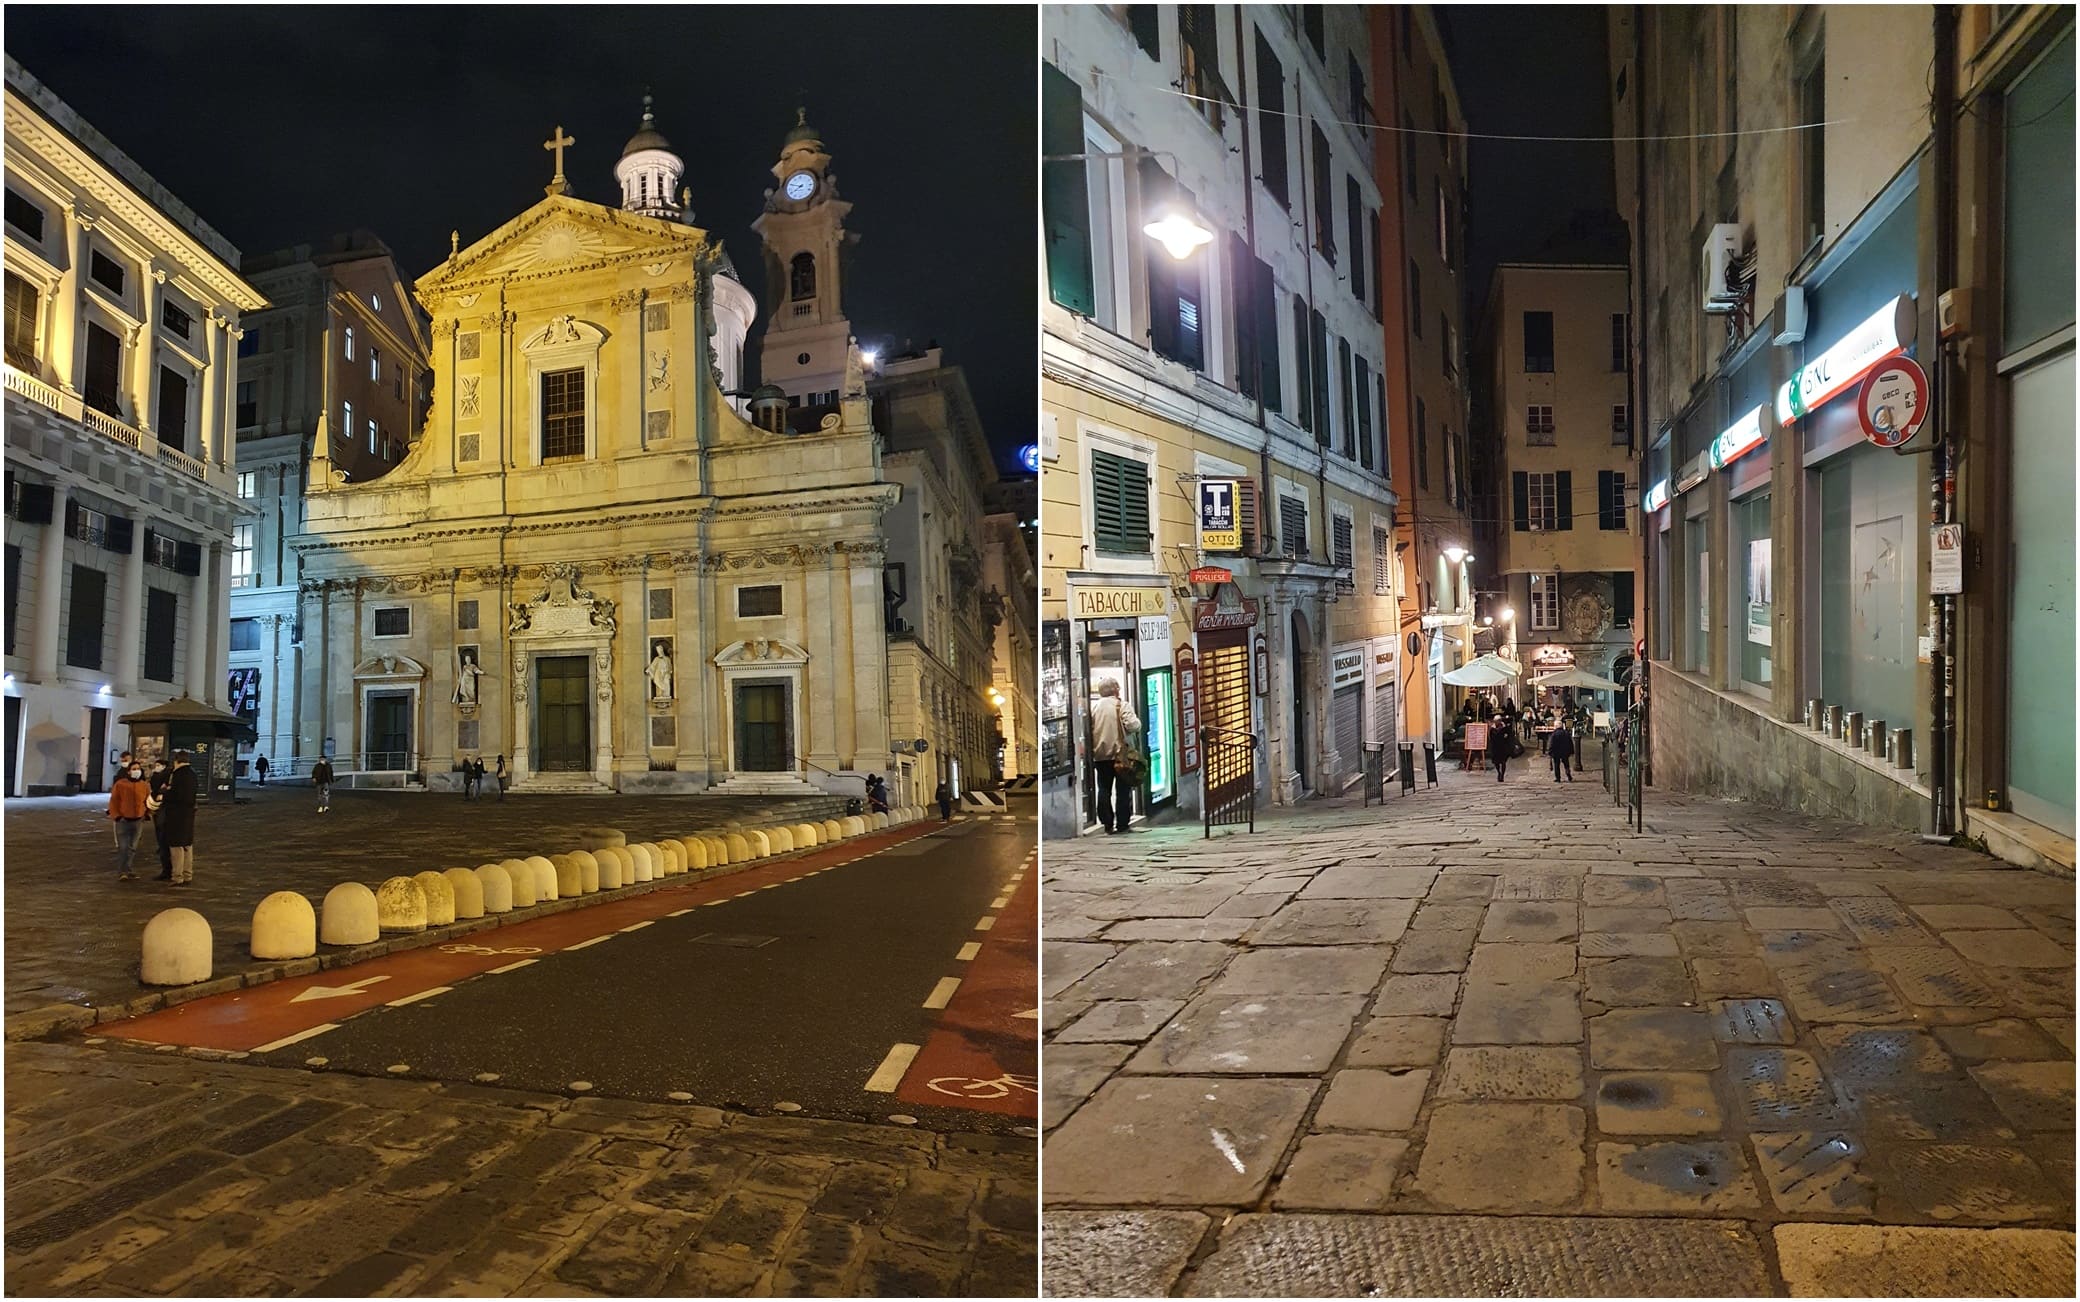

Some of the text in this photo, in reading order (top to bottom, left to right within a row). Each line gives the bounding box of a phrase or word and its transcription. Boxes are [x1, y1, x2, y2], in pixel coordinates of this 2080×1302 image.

[1206, 485, 1228, 517] T
[1203, 535, 1234, 543] LOTTO
[1078, 591, 1142, 614] TABACCHI
[1140, 621, 1169, 642] SELF 24H
[1198, 615, 1224, 629] AGENZIA
[1334, 654, 1362, 671] VASSALLO
